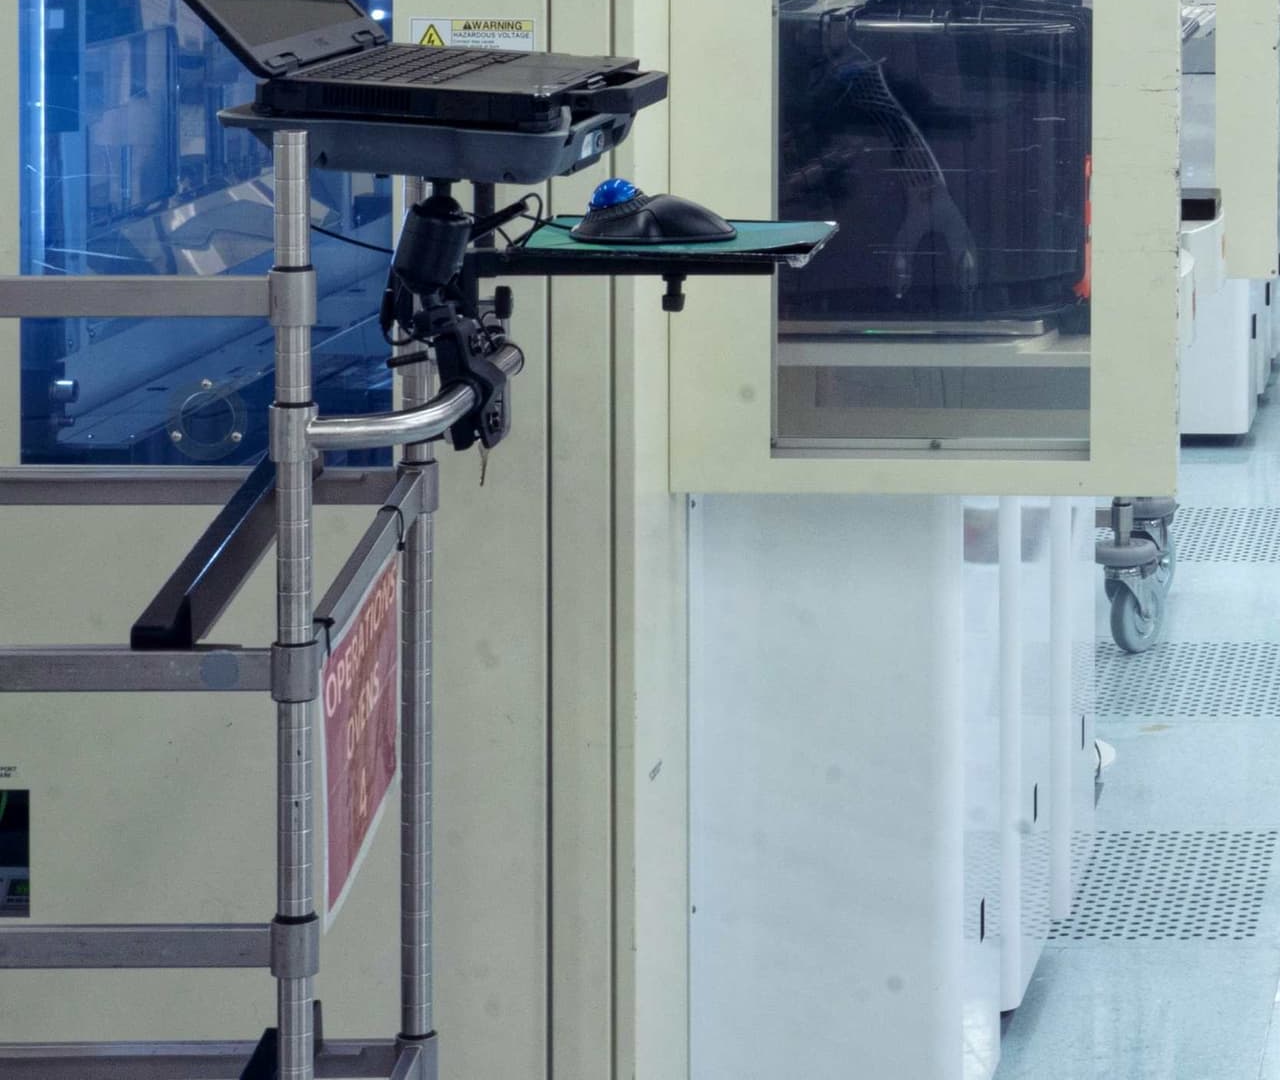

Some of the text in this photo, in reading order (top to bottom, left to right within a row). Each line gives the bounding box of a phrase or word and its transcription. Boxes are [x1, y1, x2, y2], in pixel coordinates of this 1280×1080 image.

[453, 31, 496, 39] HAZARDOUS
[472, 21, 523, 30] WARNING
[326, 564, 397, 718] OPERATIONS
[346, 661, 380, 759] OVENS
